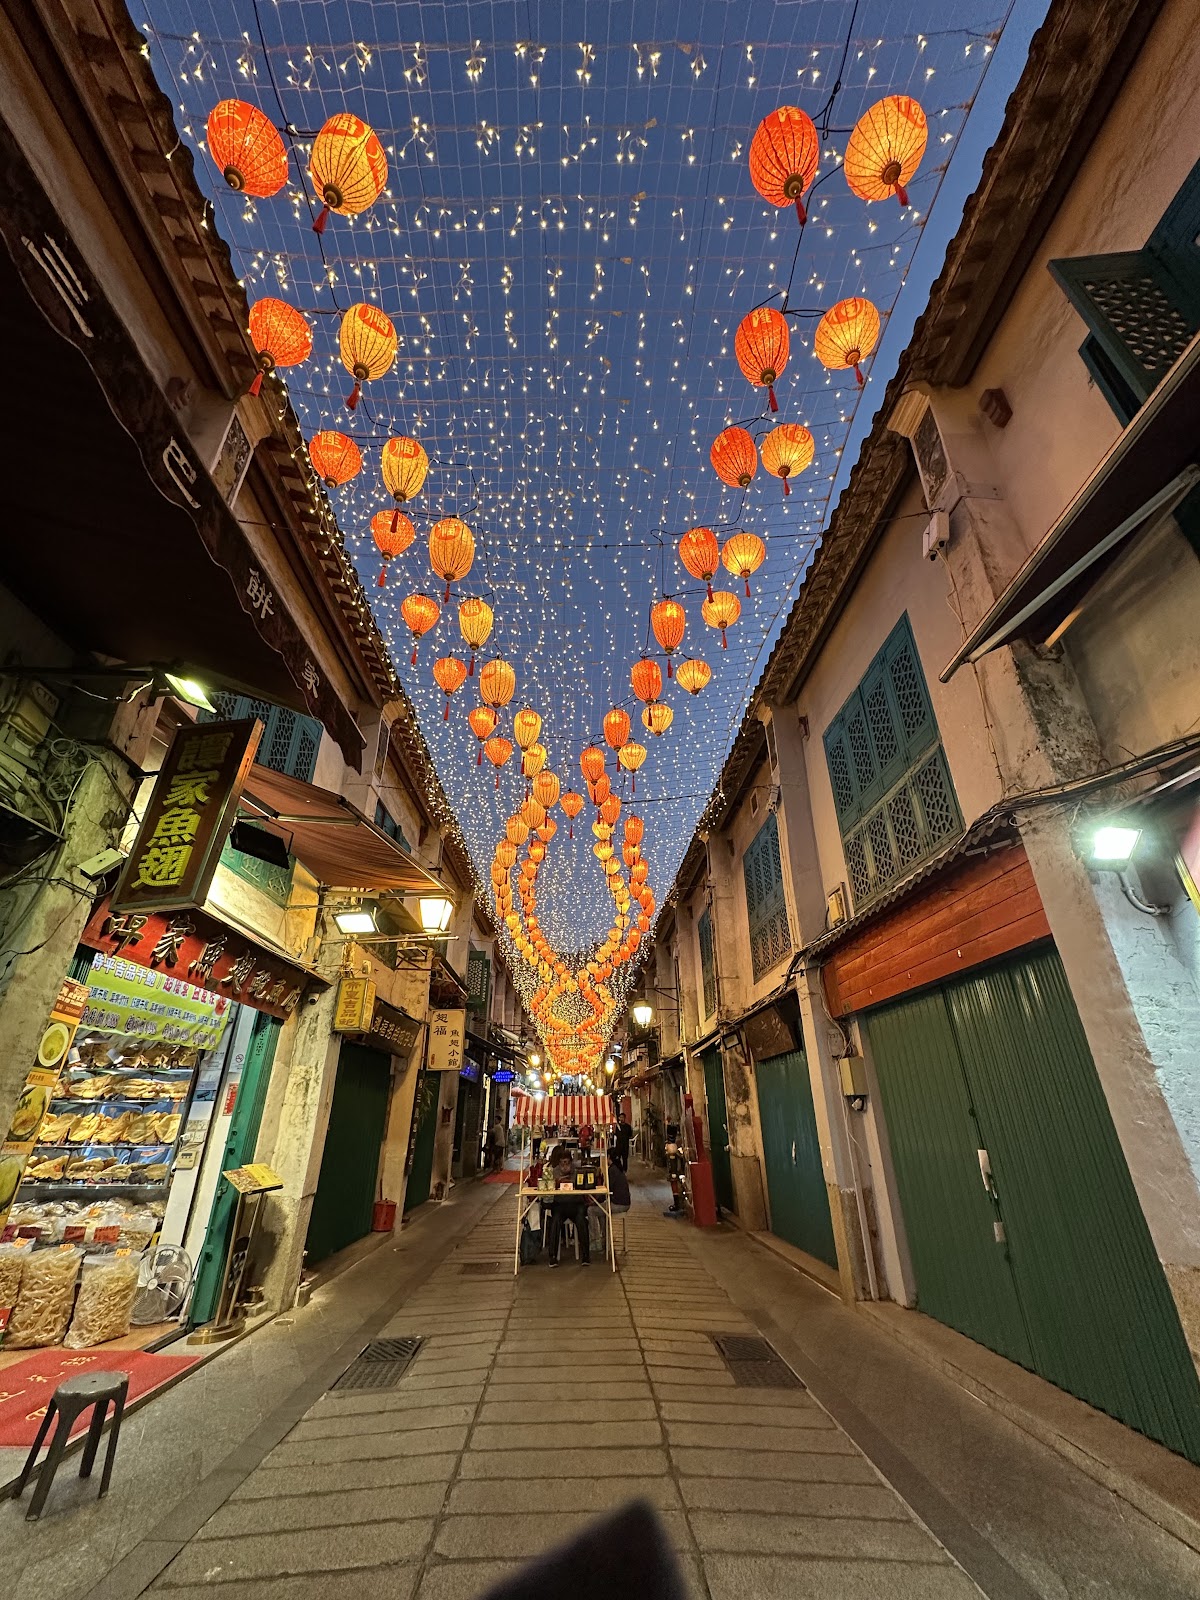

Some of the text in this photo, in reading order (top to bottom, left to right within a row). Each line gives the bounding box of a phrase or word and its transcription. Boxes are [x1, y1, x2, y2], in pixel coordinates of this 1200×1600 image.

[131, 731, 235, 889] 譚家魚翅
[433, 1013, 449, 1037] 翅福
[447, 1029, 460, 1067] 魚翅小館
